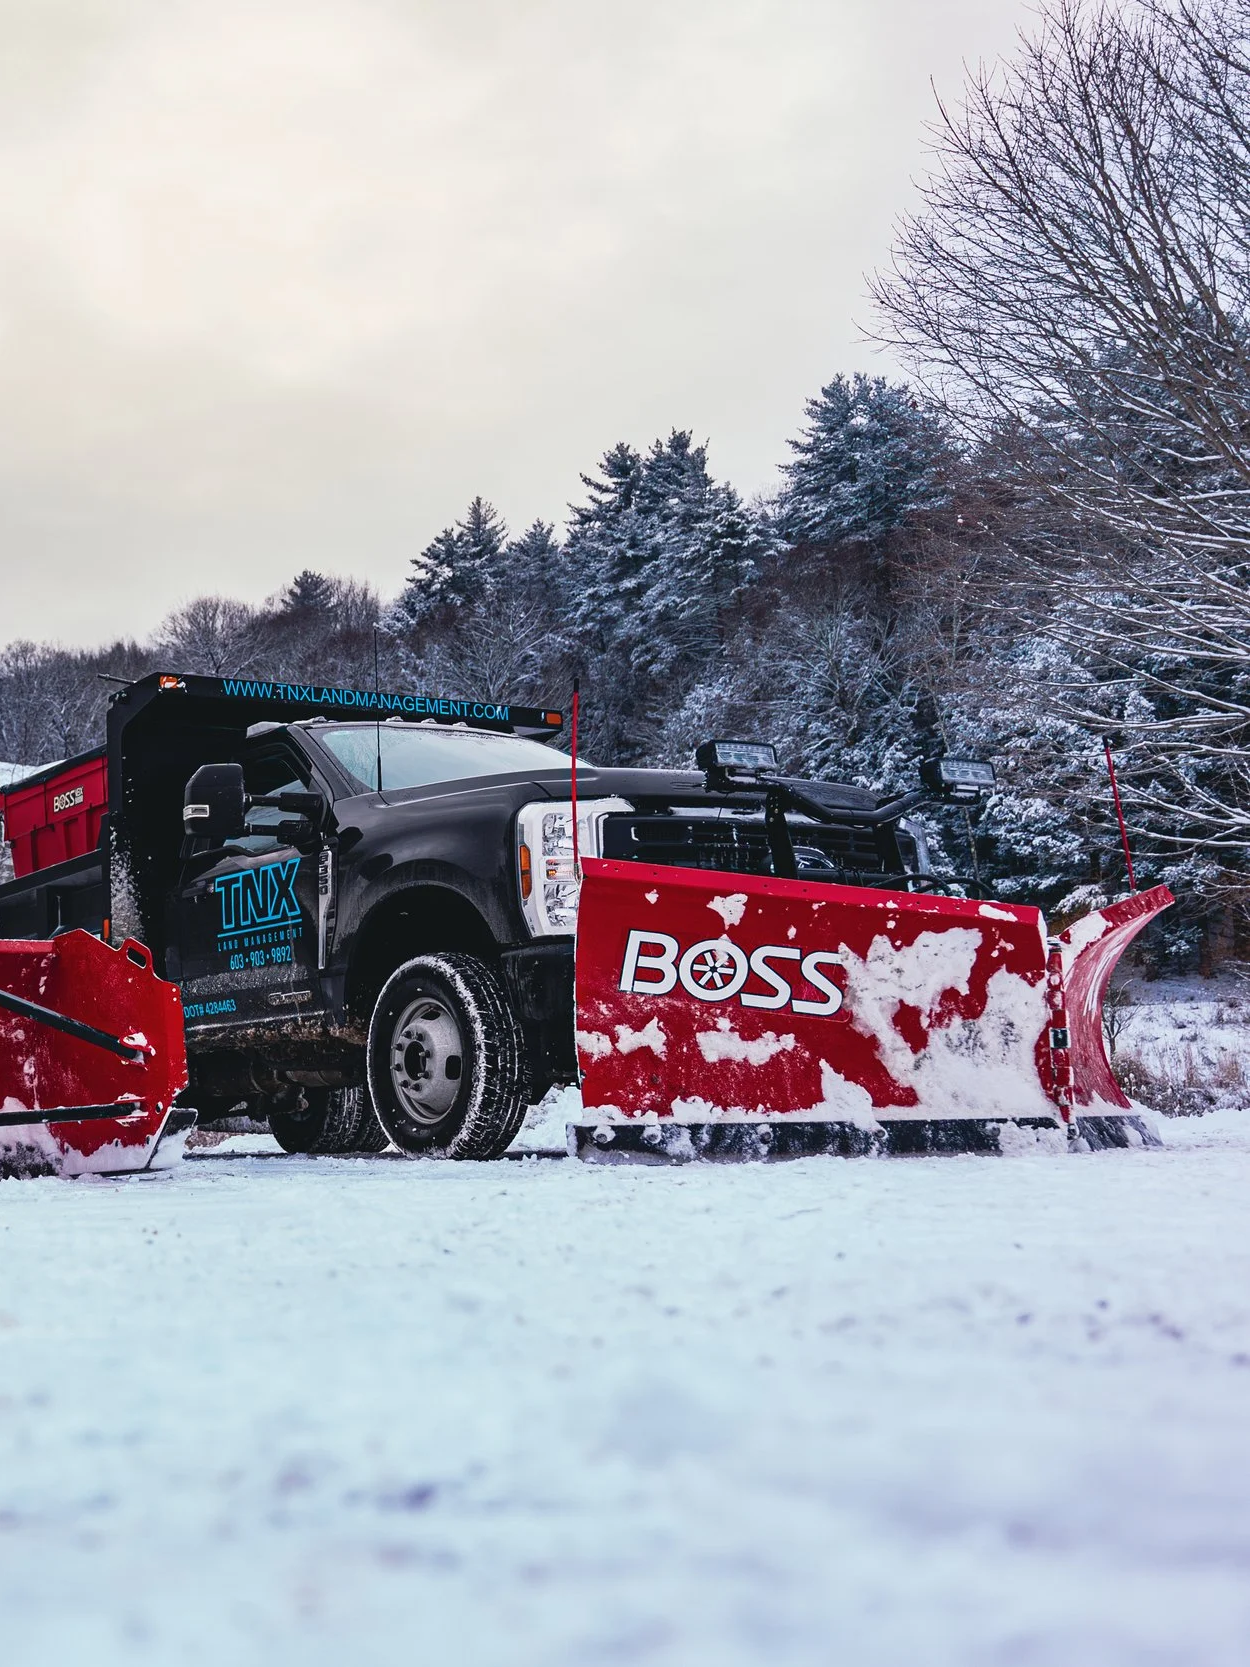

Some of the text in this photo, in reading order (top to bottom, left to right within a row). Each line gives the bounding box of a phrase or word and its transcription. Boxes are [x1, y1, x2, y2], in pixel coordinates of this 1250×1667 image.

[222, 679, 510, 721] WWW.TNXLANDMANAGEMENT.COM
[53, 790, 75, 812] BOSS
[214, 857, 301, 930] TNX
[217, 927, 303, 952] LAND MANAGEMENT
[618, 929, 846, 1016] BOSS
[183, 1004, 205, 1019] DOT#
